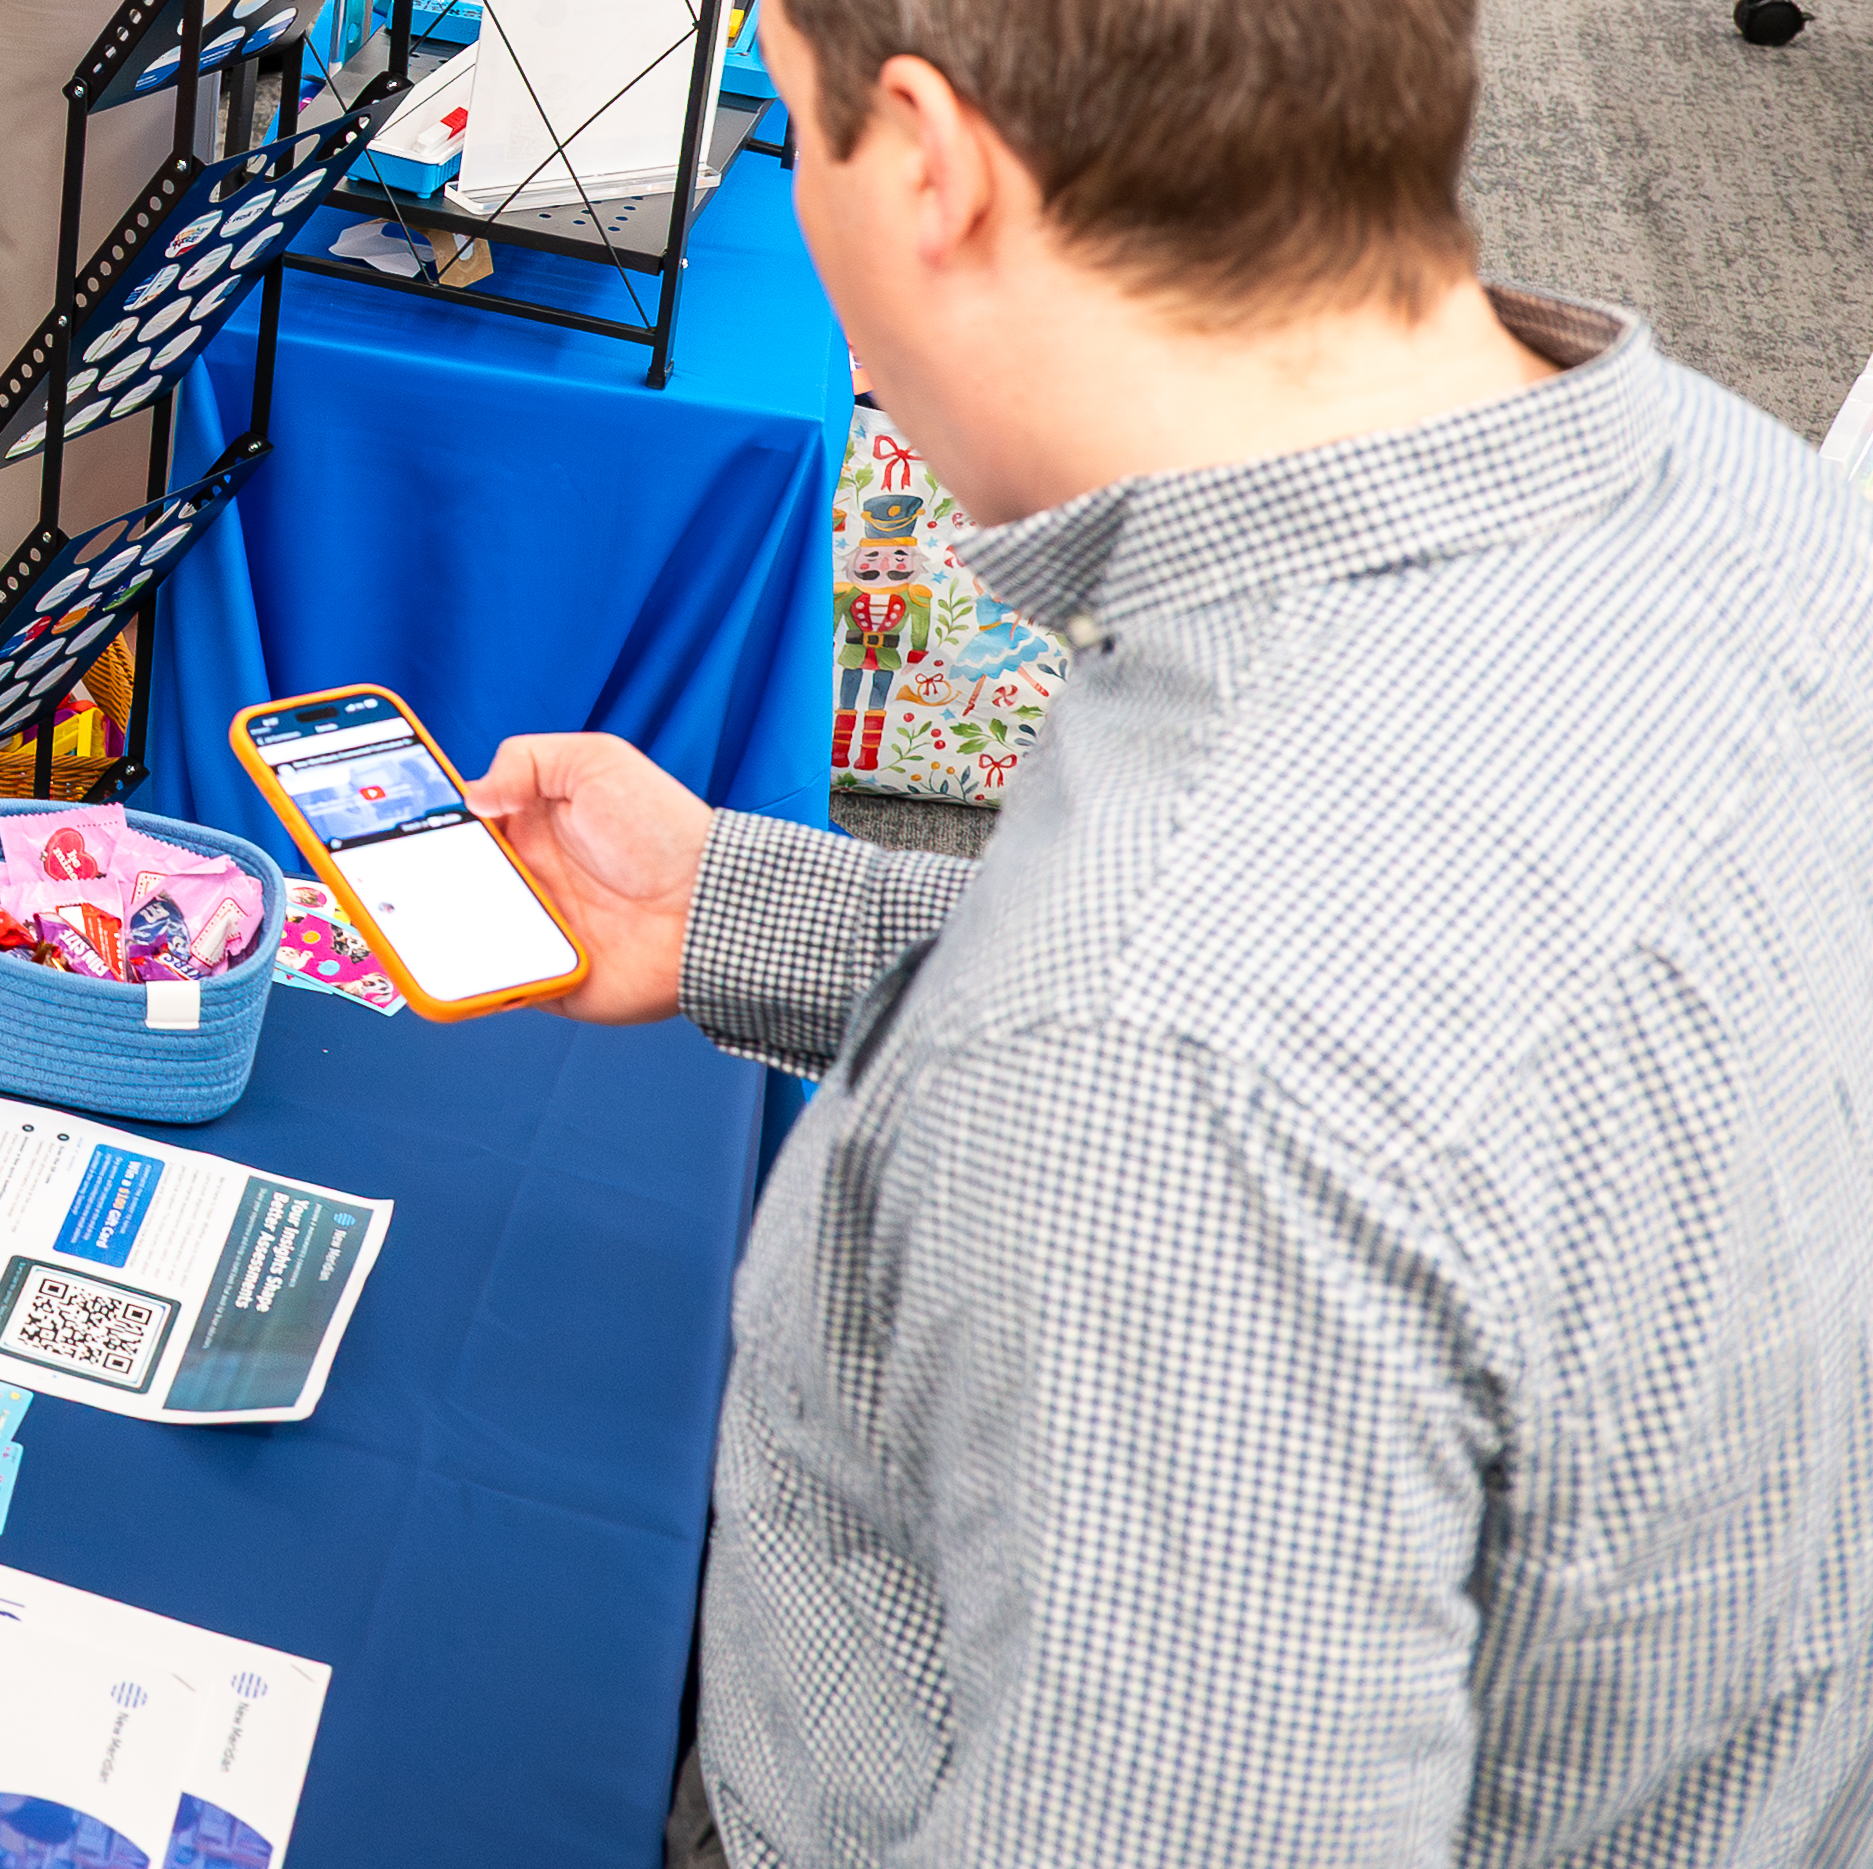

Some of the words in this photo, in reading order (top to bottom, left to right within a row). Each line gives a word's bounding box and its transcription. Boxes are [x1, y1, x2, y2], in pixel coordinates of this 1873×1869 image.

[67, 848, 82, 869] be
[121, 1178, 132, 1188] a
[124, 1160, 142, 1180] Win
[104, 1209, 122, 1228] Gift
[263, 1191, 291, 1233] Better
[290, 1198, 310, 1229] Your
[95, 1226, 115, 1249] Card
[332, 1228, 348, 1247] New
[270, 1225, 301, 1282] Insights
[317, 1246, 342, 1282] Meridian
[235, 1230, 276, 1310] Assessments
[255, 1275, 284, 1313] Shape
[114, 1711, 130, 1741] New
[234, 1700, 251, 1731] New
[98, 1737, 121, 1786] Meridian
[219, 1728, 244, 1775] Meridian
